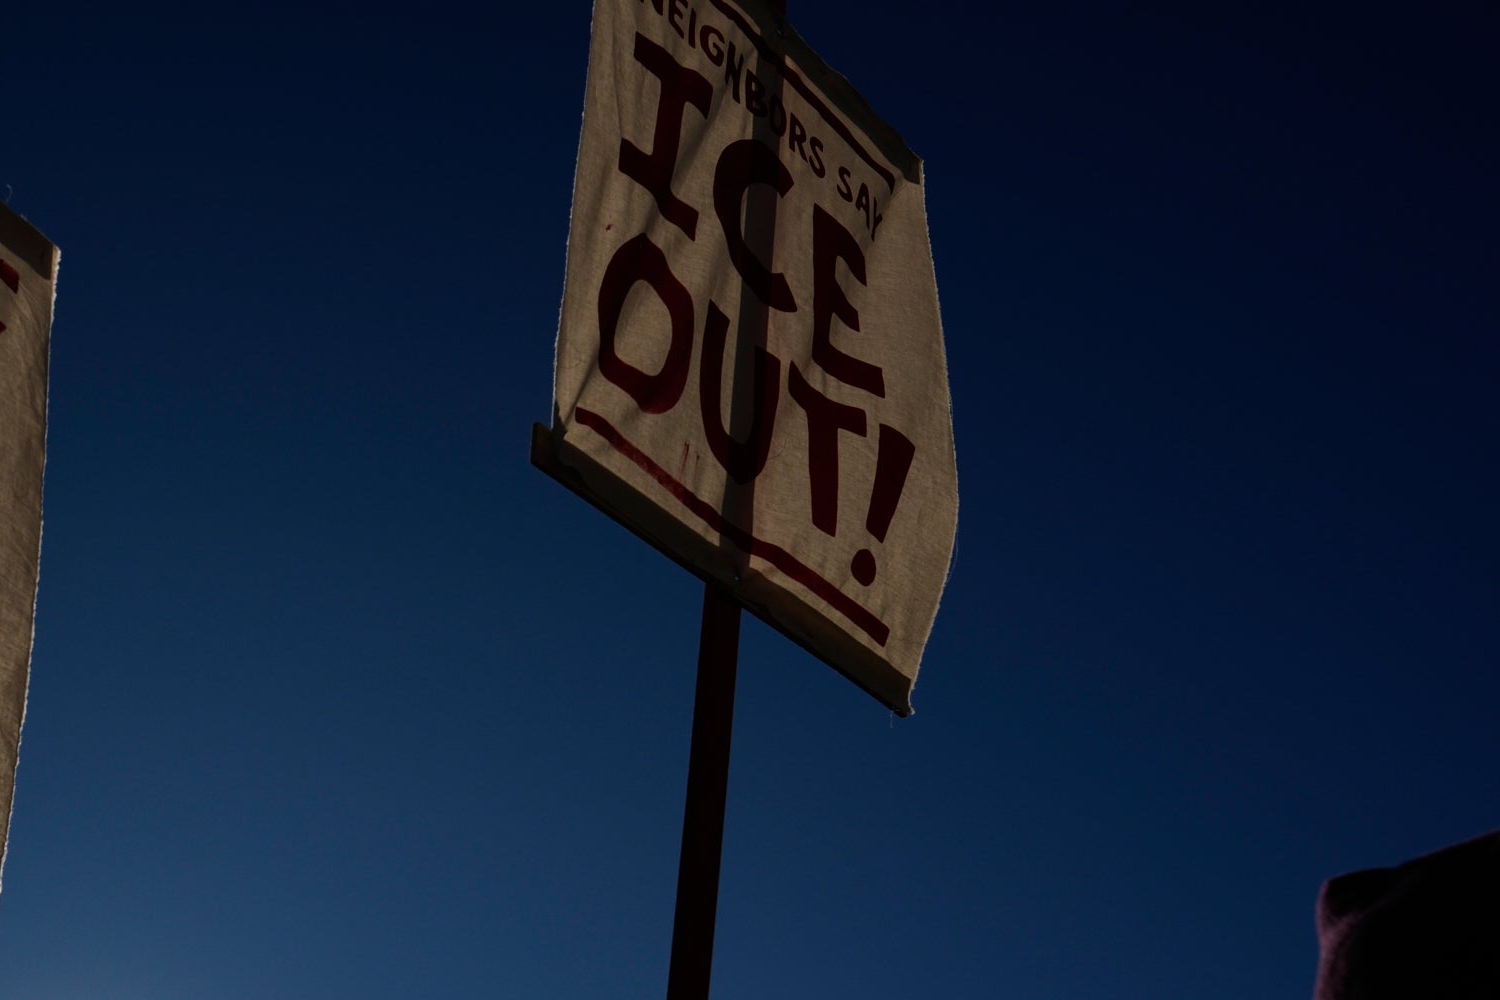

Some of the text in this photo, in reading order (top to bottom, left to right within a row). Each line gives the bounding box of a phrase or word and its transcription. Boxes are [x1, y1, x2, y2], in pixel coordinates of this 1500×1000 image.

[618, 31, 886, 398] ICE
[640, 0, 886, 241] EIGHBORS SAY
[598, 232, 915, 587] OUT!
